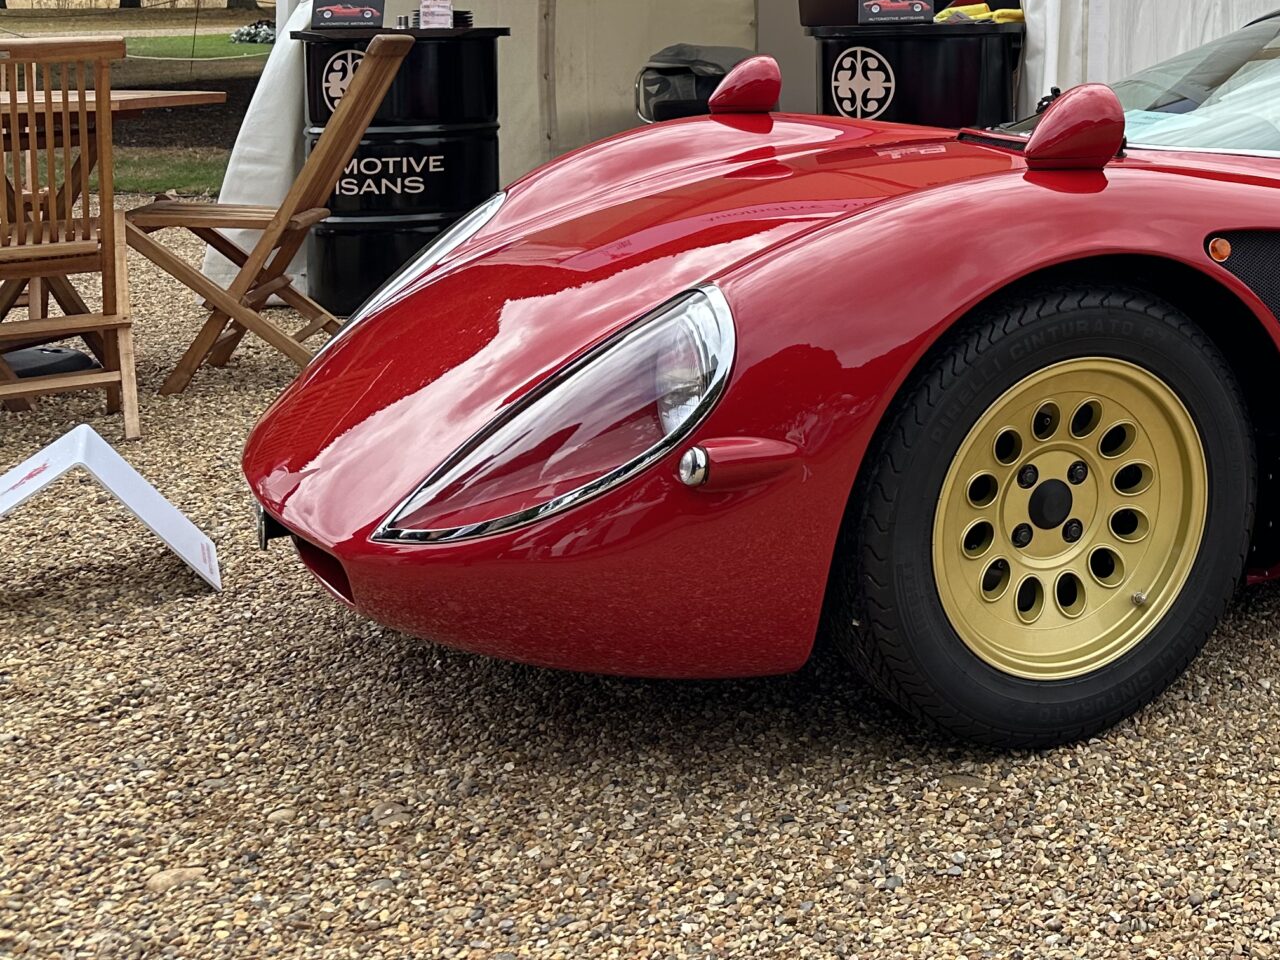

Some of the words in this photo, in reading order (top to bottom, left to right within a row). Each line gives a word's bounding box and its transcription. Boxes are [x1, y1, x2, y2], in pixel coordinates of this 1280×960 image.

[343, 155, 445, 175] MOTIVE
[335, 176, 425, 195] ISANS
[928, 357, 1004, 446] PIRELLI
[1009, 318, 1135, 360] CINTURATO
